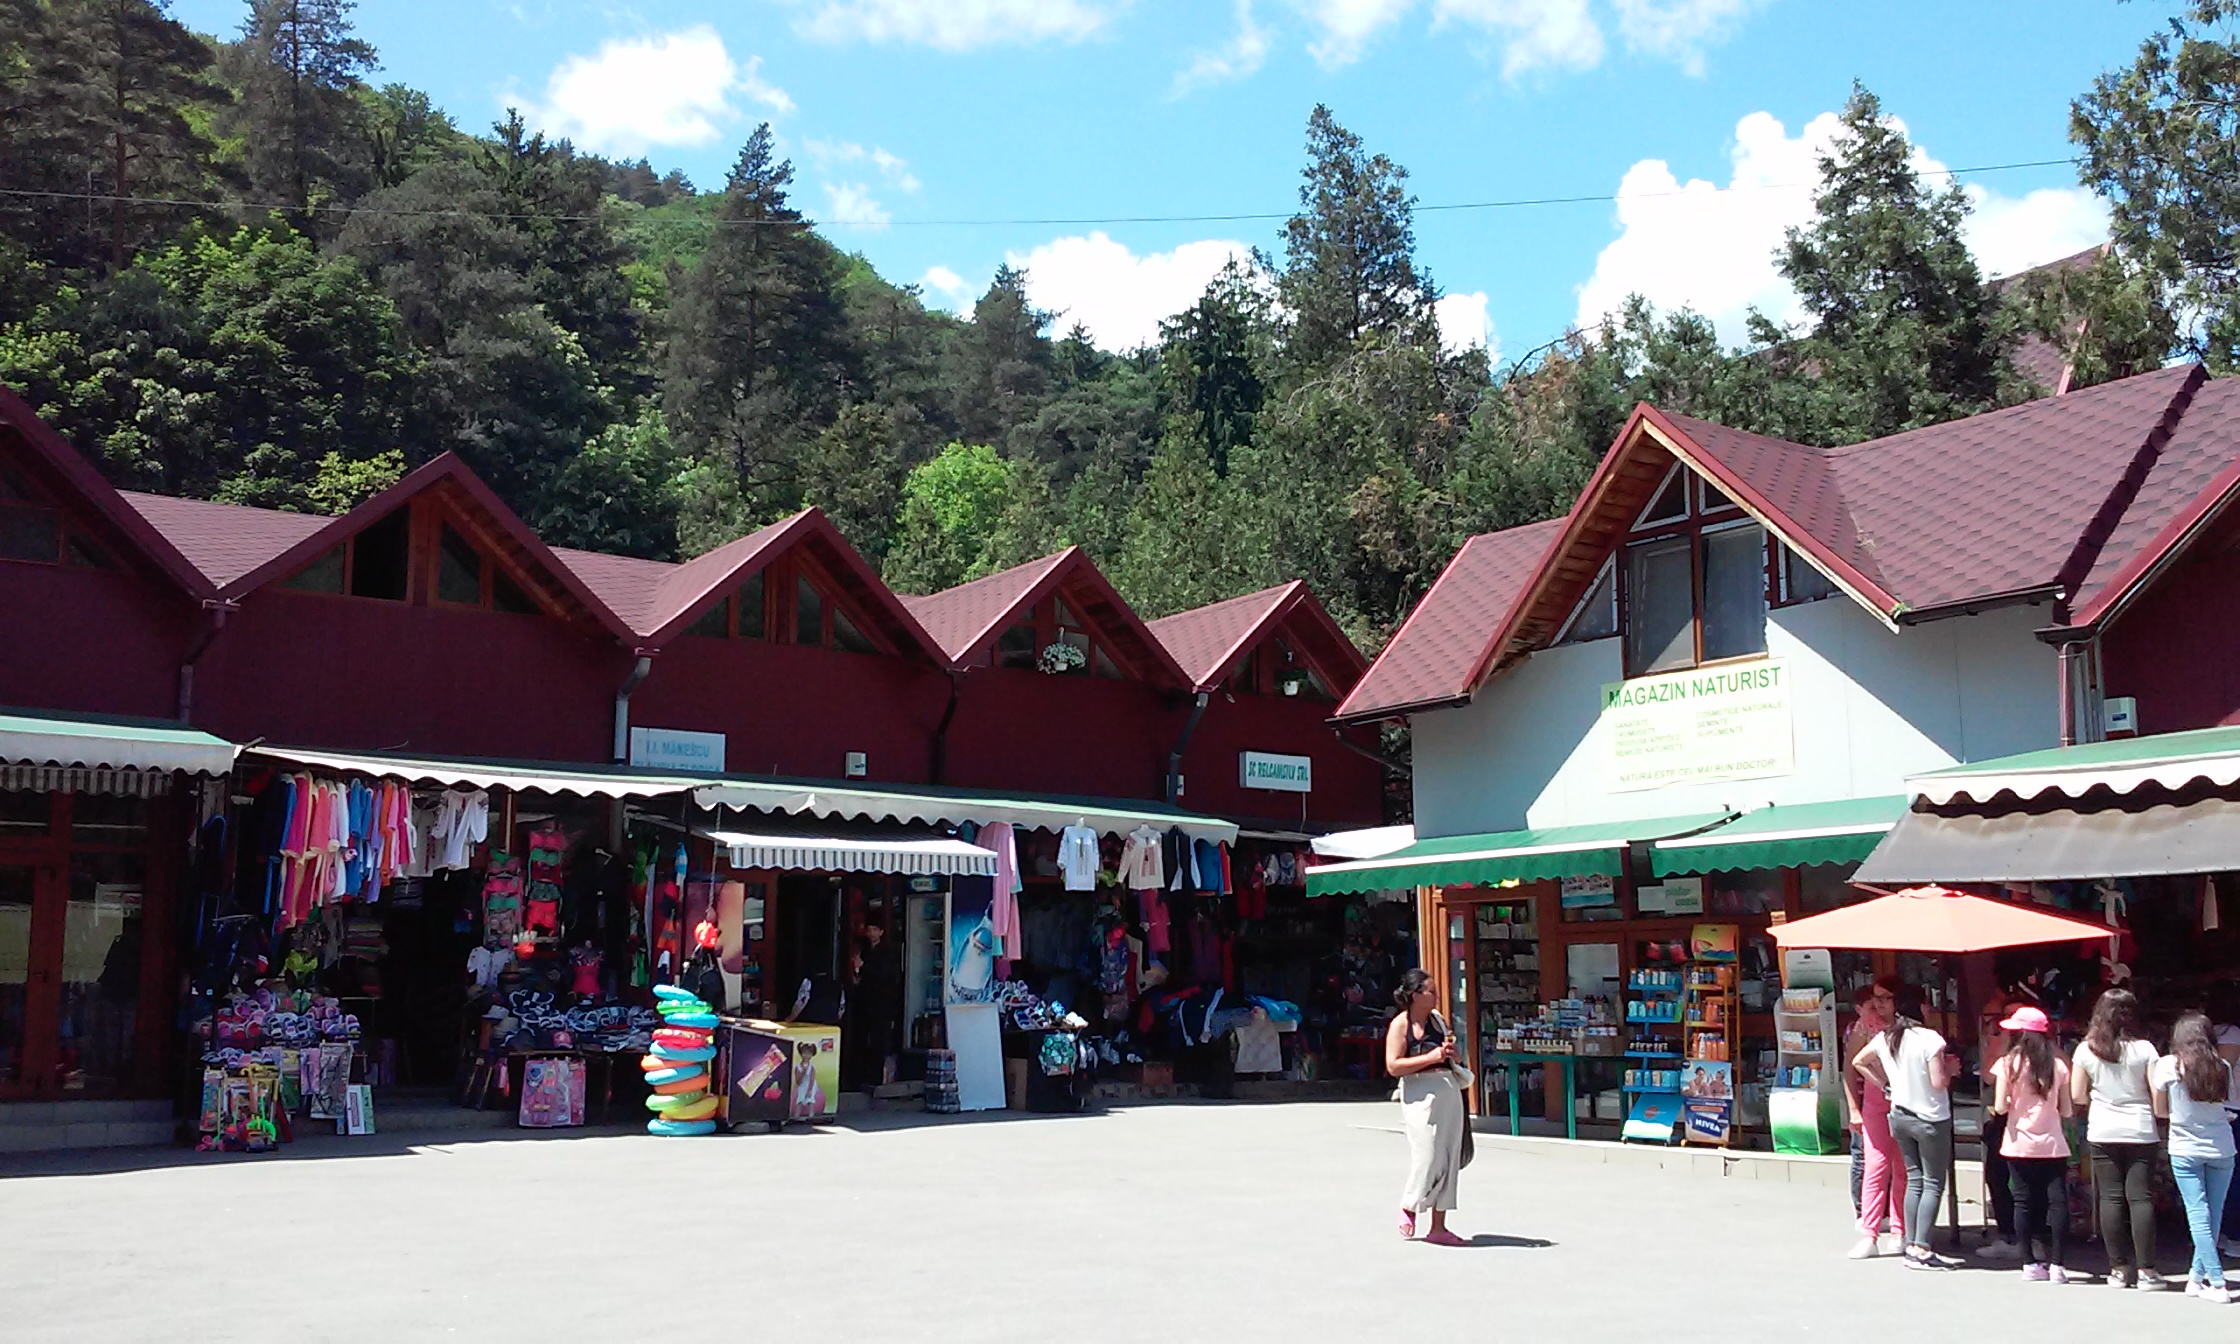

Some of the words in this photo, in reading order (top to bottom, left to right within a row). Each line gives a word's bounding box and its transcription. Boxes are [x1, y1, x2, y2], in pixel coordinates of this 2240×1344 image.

[1609, 681, 1686, 709] MAGAZIN
[1692, 666, 1781, 697] NATURIST
[1695, 706, 1739, 719] COSMETICE
[1741, 701, 1784, 712] NATURALE
[1297, 766, 1309, 781] SRL
[1619, 771, 1653, 782] NATURA
[1654, 768, 1675, 779] ESTE
[1678, 767, 1693, 777] CEL
[1696, 765, 1713, 775] MAI
[1715, 761, 1734, 773] BUN
[1695, 1118, 1720, 1133] NIVEA
